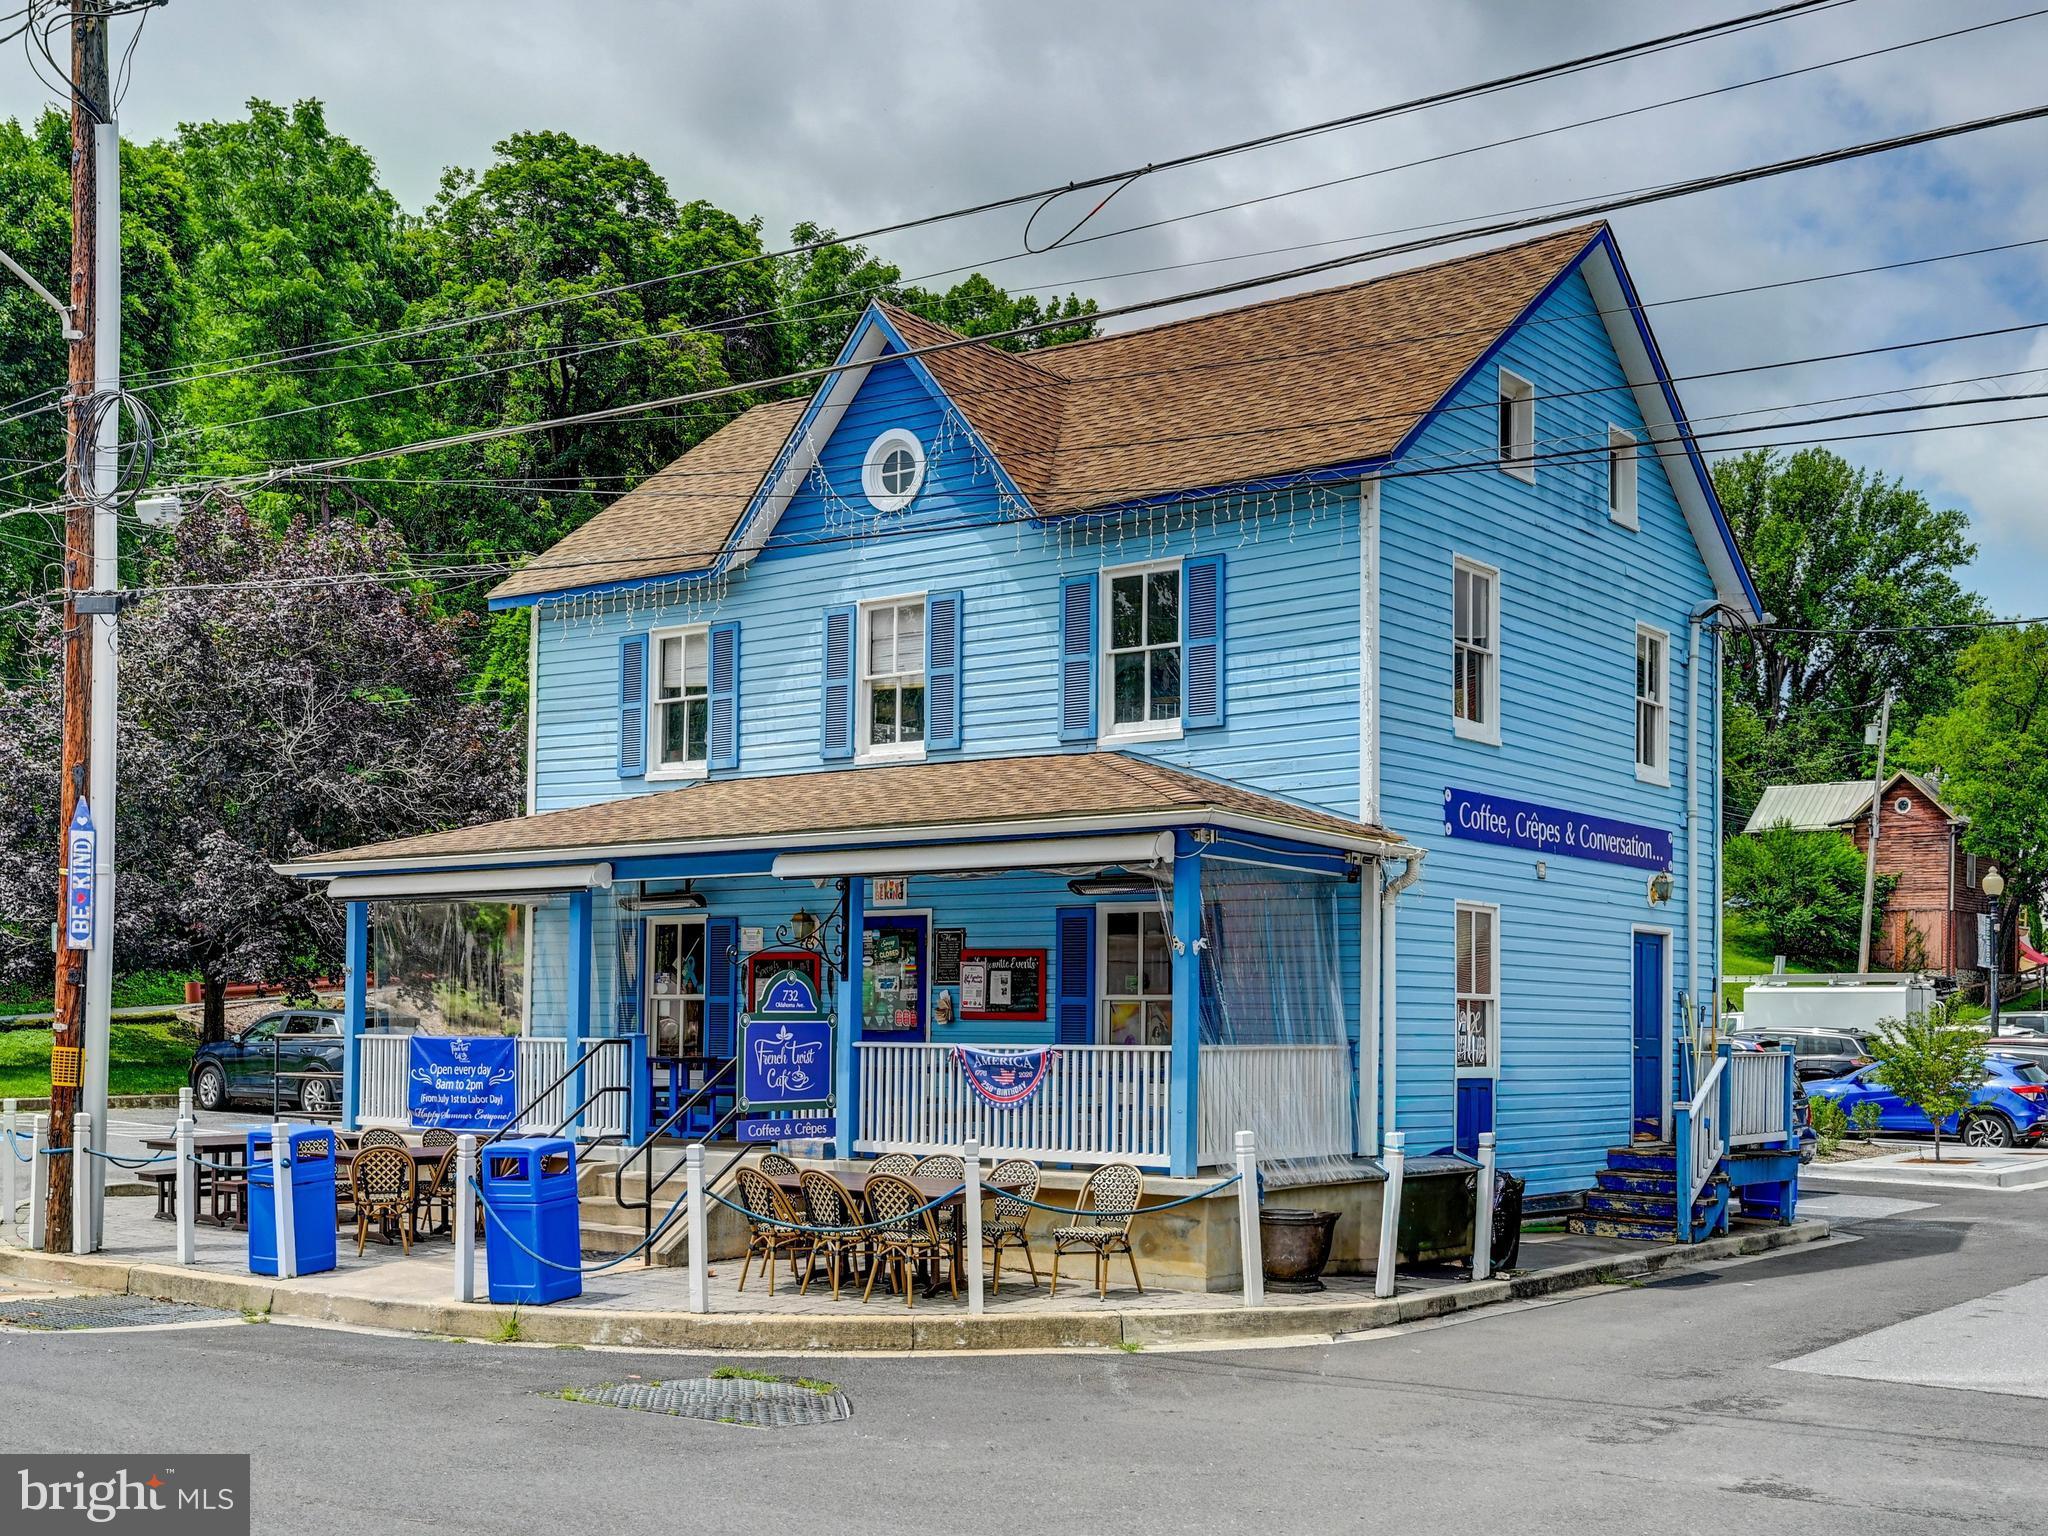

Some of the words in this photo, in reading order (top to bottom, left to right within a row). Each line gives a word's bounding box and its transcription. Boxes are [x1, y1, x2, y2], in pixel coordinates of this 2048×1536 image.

[1459, 802, 1511, 839] Coffee,
[1515, 812, 1560, 848] Crêpes
[1565, 821, 1575, 846] &
[72, 840, 92, 890] KIND
[71, 906, 90, 934] BE
[879, 949, 900, 959] CLOSED
[782, 989, 799, 1001] 732
[754, 1039, 788, 1075] French
[973, 1054, 1035, 1070] AMERICA
[429, 1063, 453, 1077] Open
[454, 1065, 476, 1077] every
[477, 1063, 492, 1077] day
[435, 1079, 454, 1090] 8am
[455, 1080, 464, 1090] to
[465, 1079, 484, 1092] 2pm
[767, 1068, 791, 1097] Café
[996, 1081, 1027, 1096] BIRTHDAY
[420, 1094, 438, 1104] (From
[437, 1094, 449, 1105] July
[451, 1094, 460, 1104] 1st
[460, 1096, 467, 1104] to
[468, 1094, 488, 1104] Labor
[489, 1095, 503, 1105] Day)
[414, 1107, 440, 1126] Happy
[441, 1108, 473, 1120] Summer
[474, 1108, 511, 1128] Everyone!
[747, 1123, 781, 1137] Coffee
[784, 1123, 792, 1136] &
[795, 1121, 827, 1137] Crêpes
